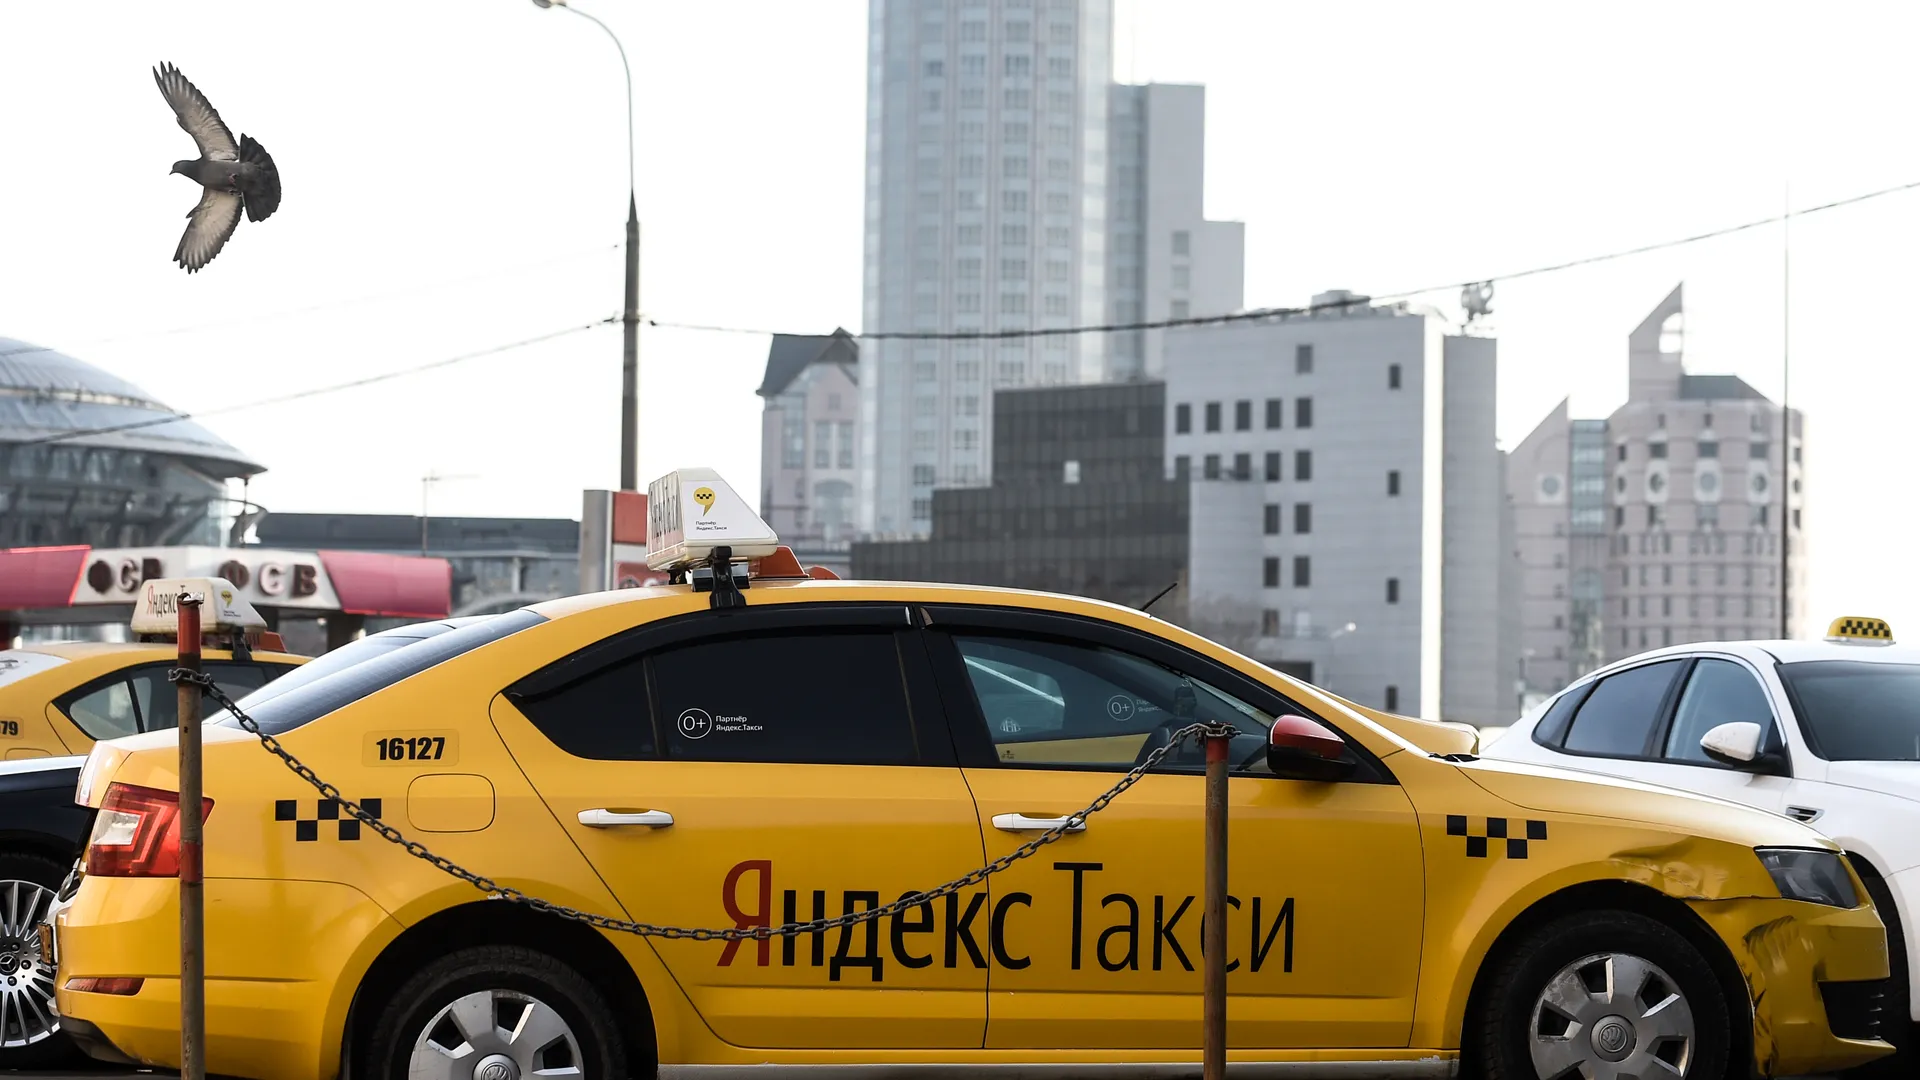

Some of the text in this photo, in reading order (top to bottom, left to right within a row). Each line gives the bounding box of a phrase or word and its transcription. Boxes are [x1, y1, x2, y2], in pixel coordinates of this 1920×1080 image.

[147, 584, 178, 618] Яндекс
[683, 715, 706, 731] 0+
[715, 715, 748, 723] Партнёр
[0, 720, 19, 736] 79
[715, 724, 763, 732] Яндекс.Такси
[376, 736, 446, 760] 16127
[716, 859, 1032, 982] Яндекс
